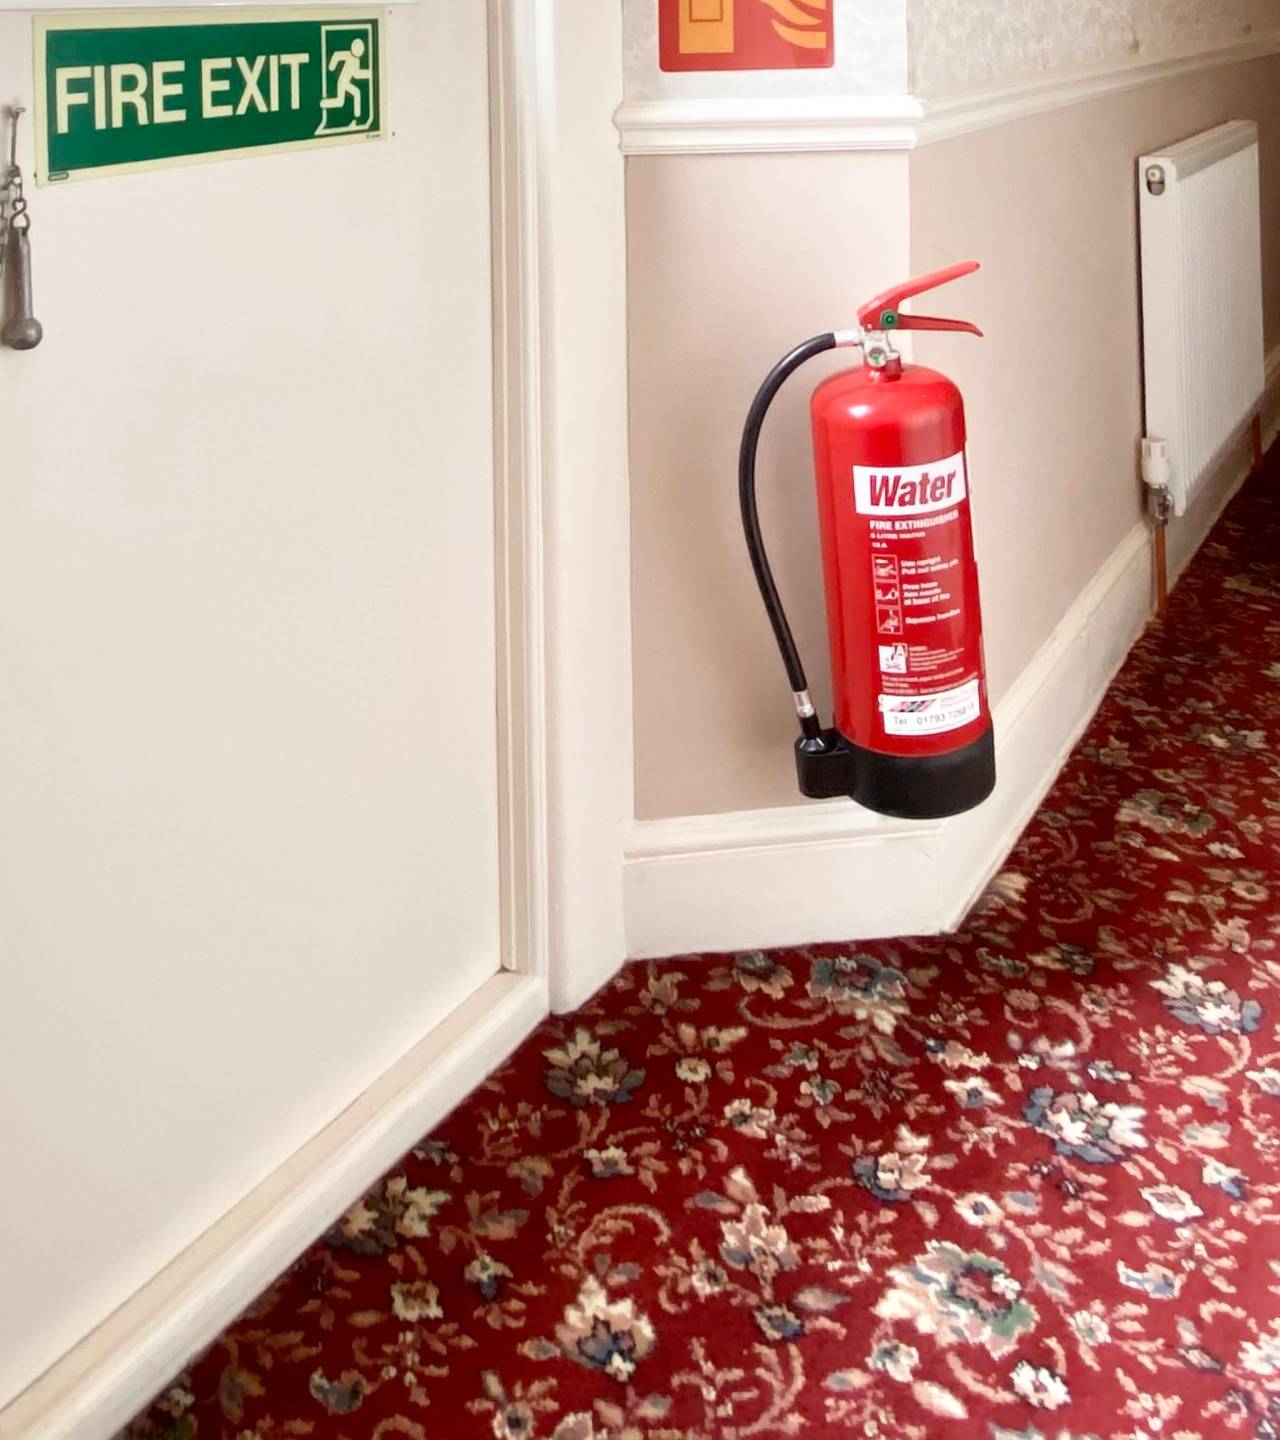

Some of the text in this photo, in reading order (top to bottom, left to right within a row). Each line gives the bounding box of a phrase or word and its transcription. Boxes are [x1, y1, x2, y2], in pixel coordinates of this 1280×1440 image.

[55, 52, 310, 134] FIRE EXIT
[869, 470, 957, 508] Water
[869, 510, 959, 531] FIRE EXTINGUISHER
